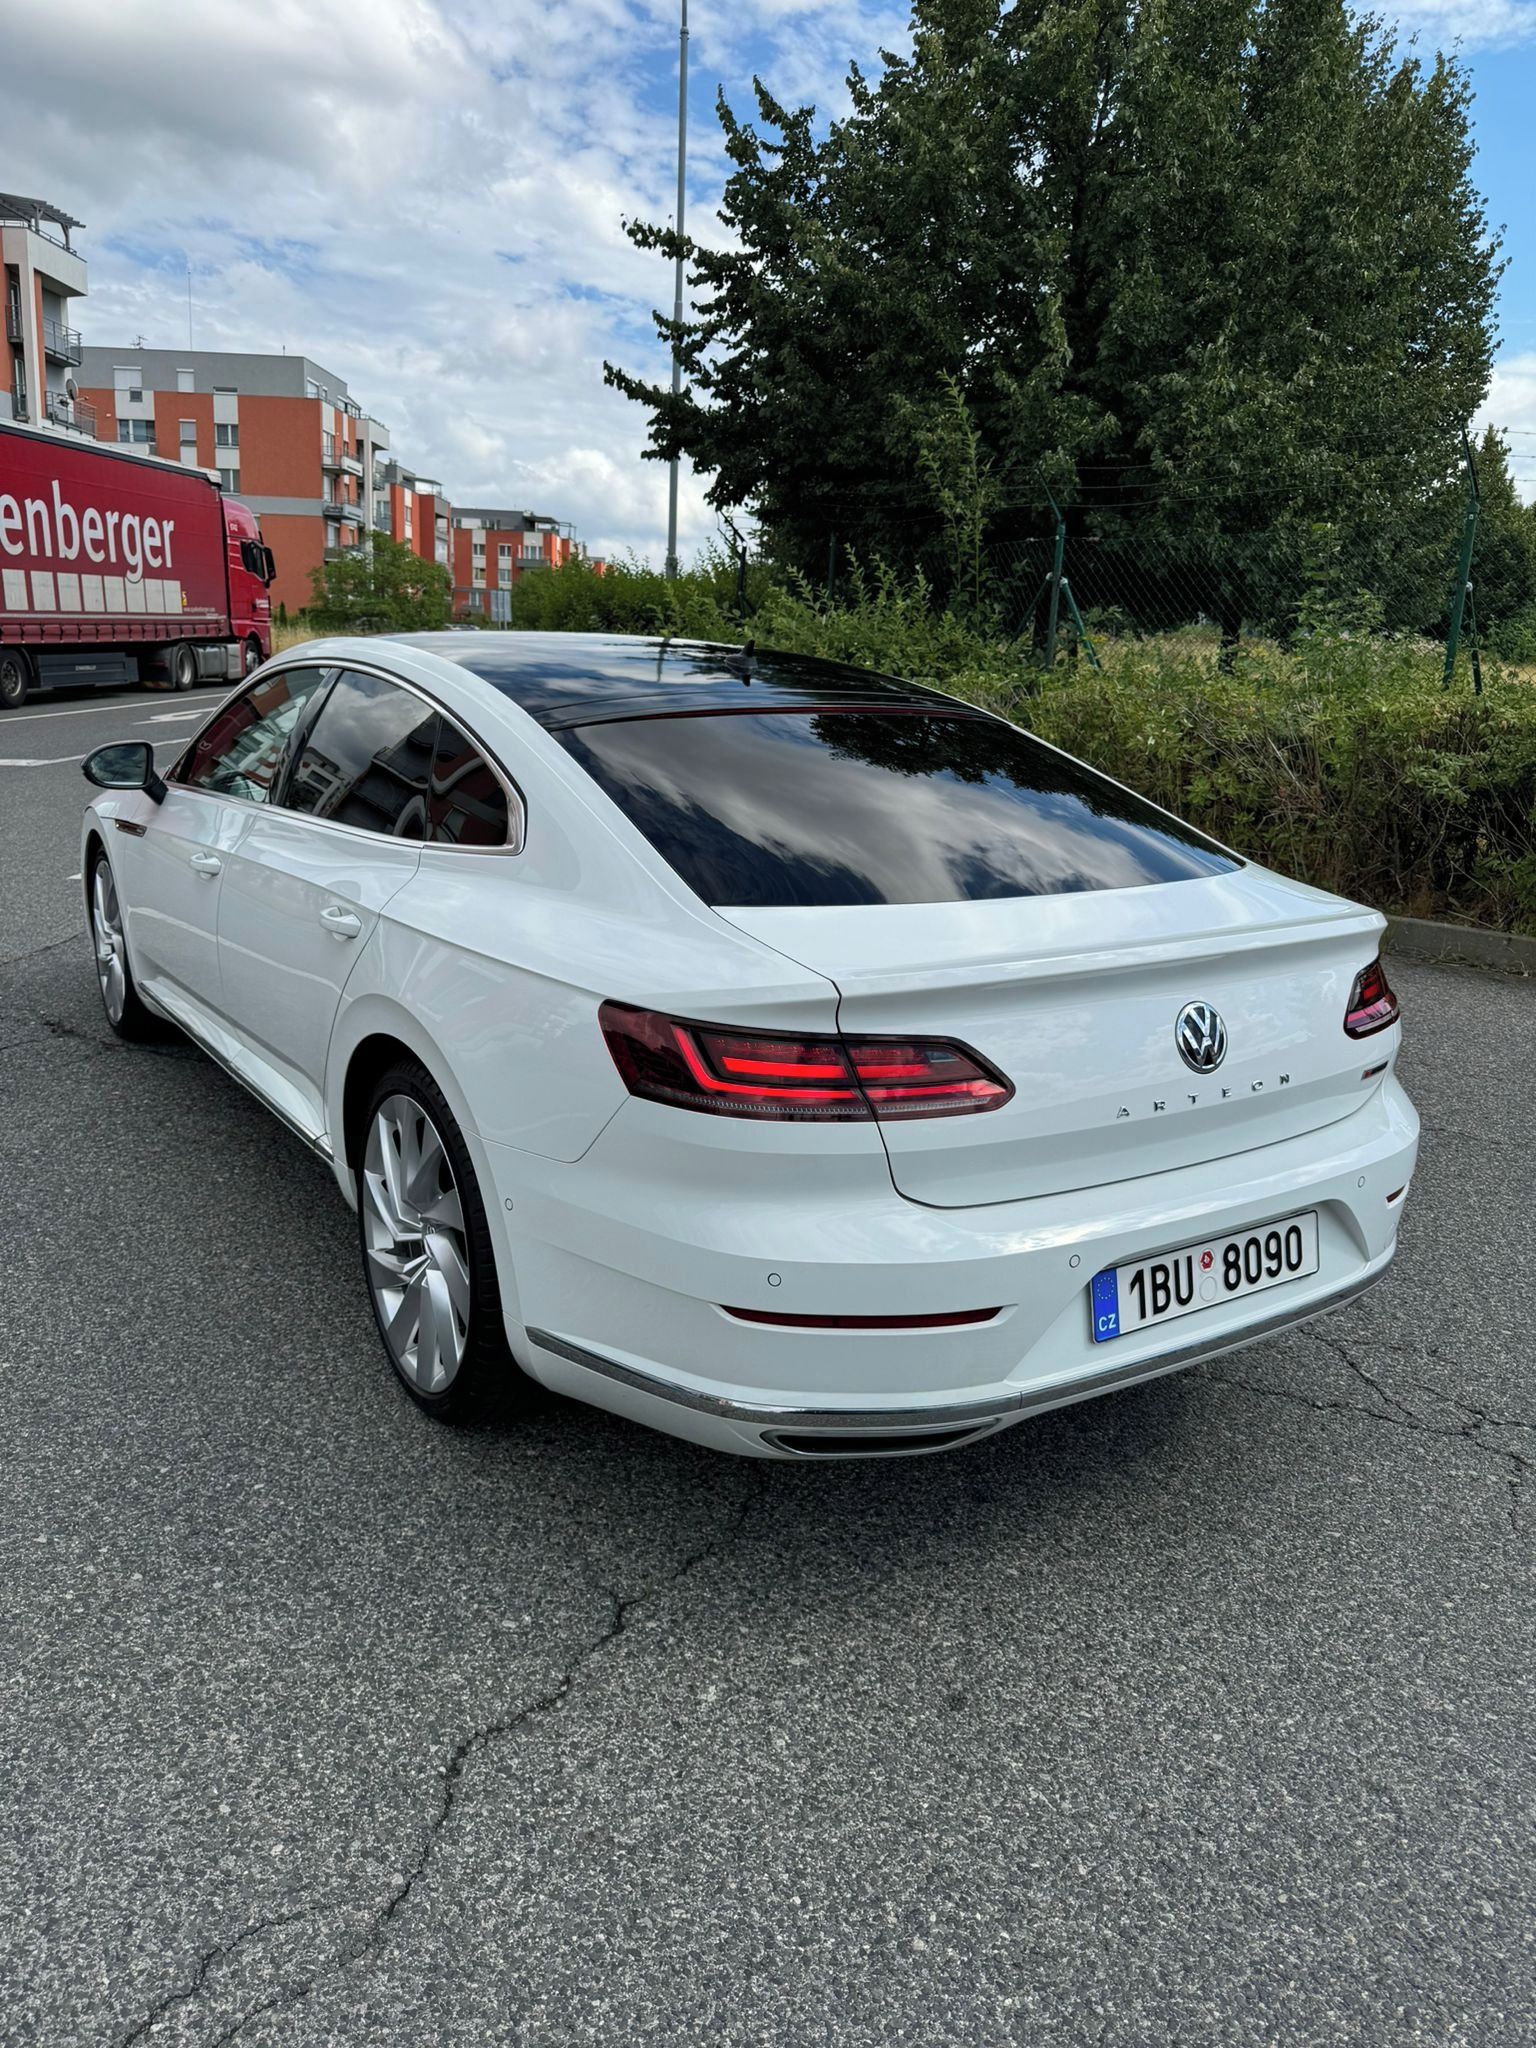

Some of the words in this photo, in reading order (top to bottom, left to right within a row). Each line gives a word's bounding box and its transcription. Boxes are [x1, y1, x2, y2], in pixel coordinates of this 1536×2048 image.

[1176, 1001, 1227, 1073] VW
[1116, 1073, 1290, 1119] ARTEON
[1129, 1255, 1194, 1320] 1BU
[1223, 1224, 1303, 1291] 8090
[1099, 1313, 1116, 1332] CZ
